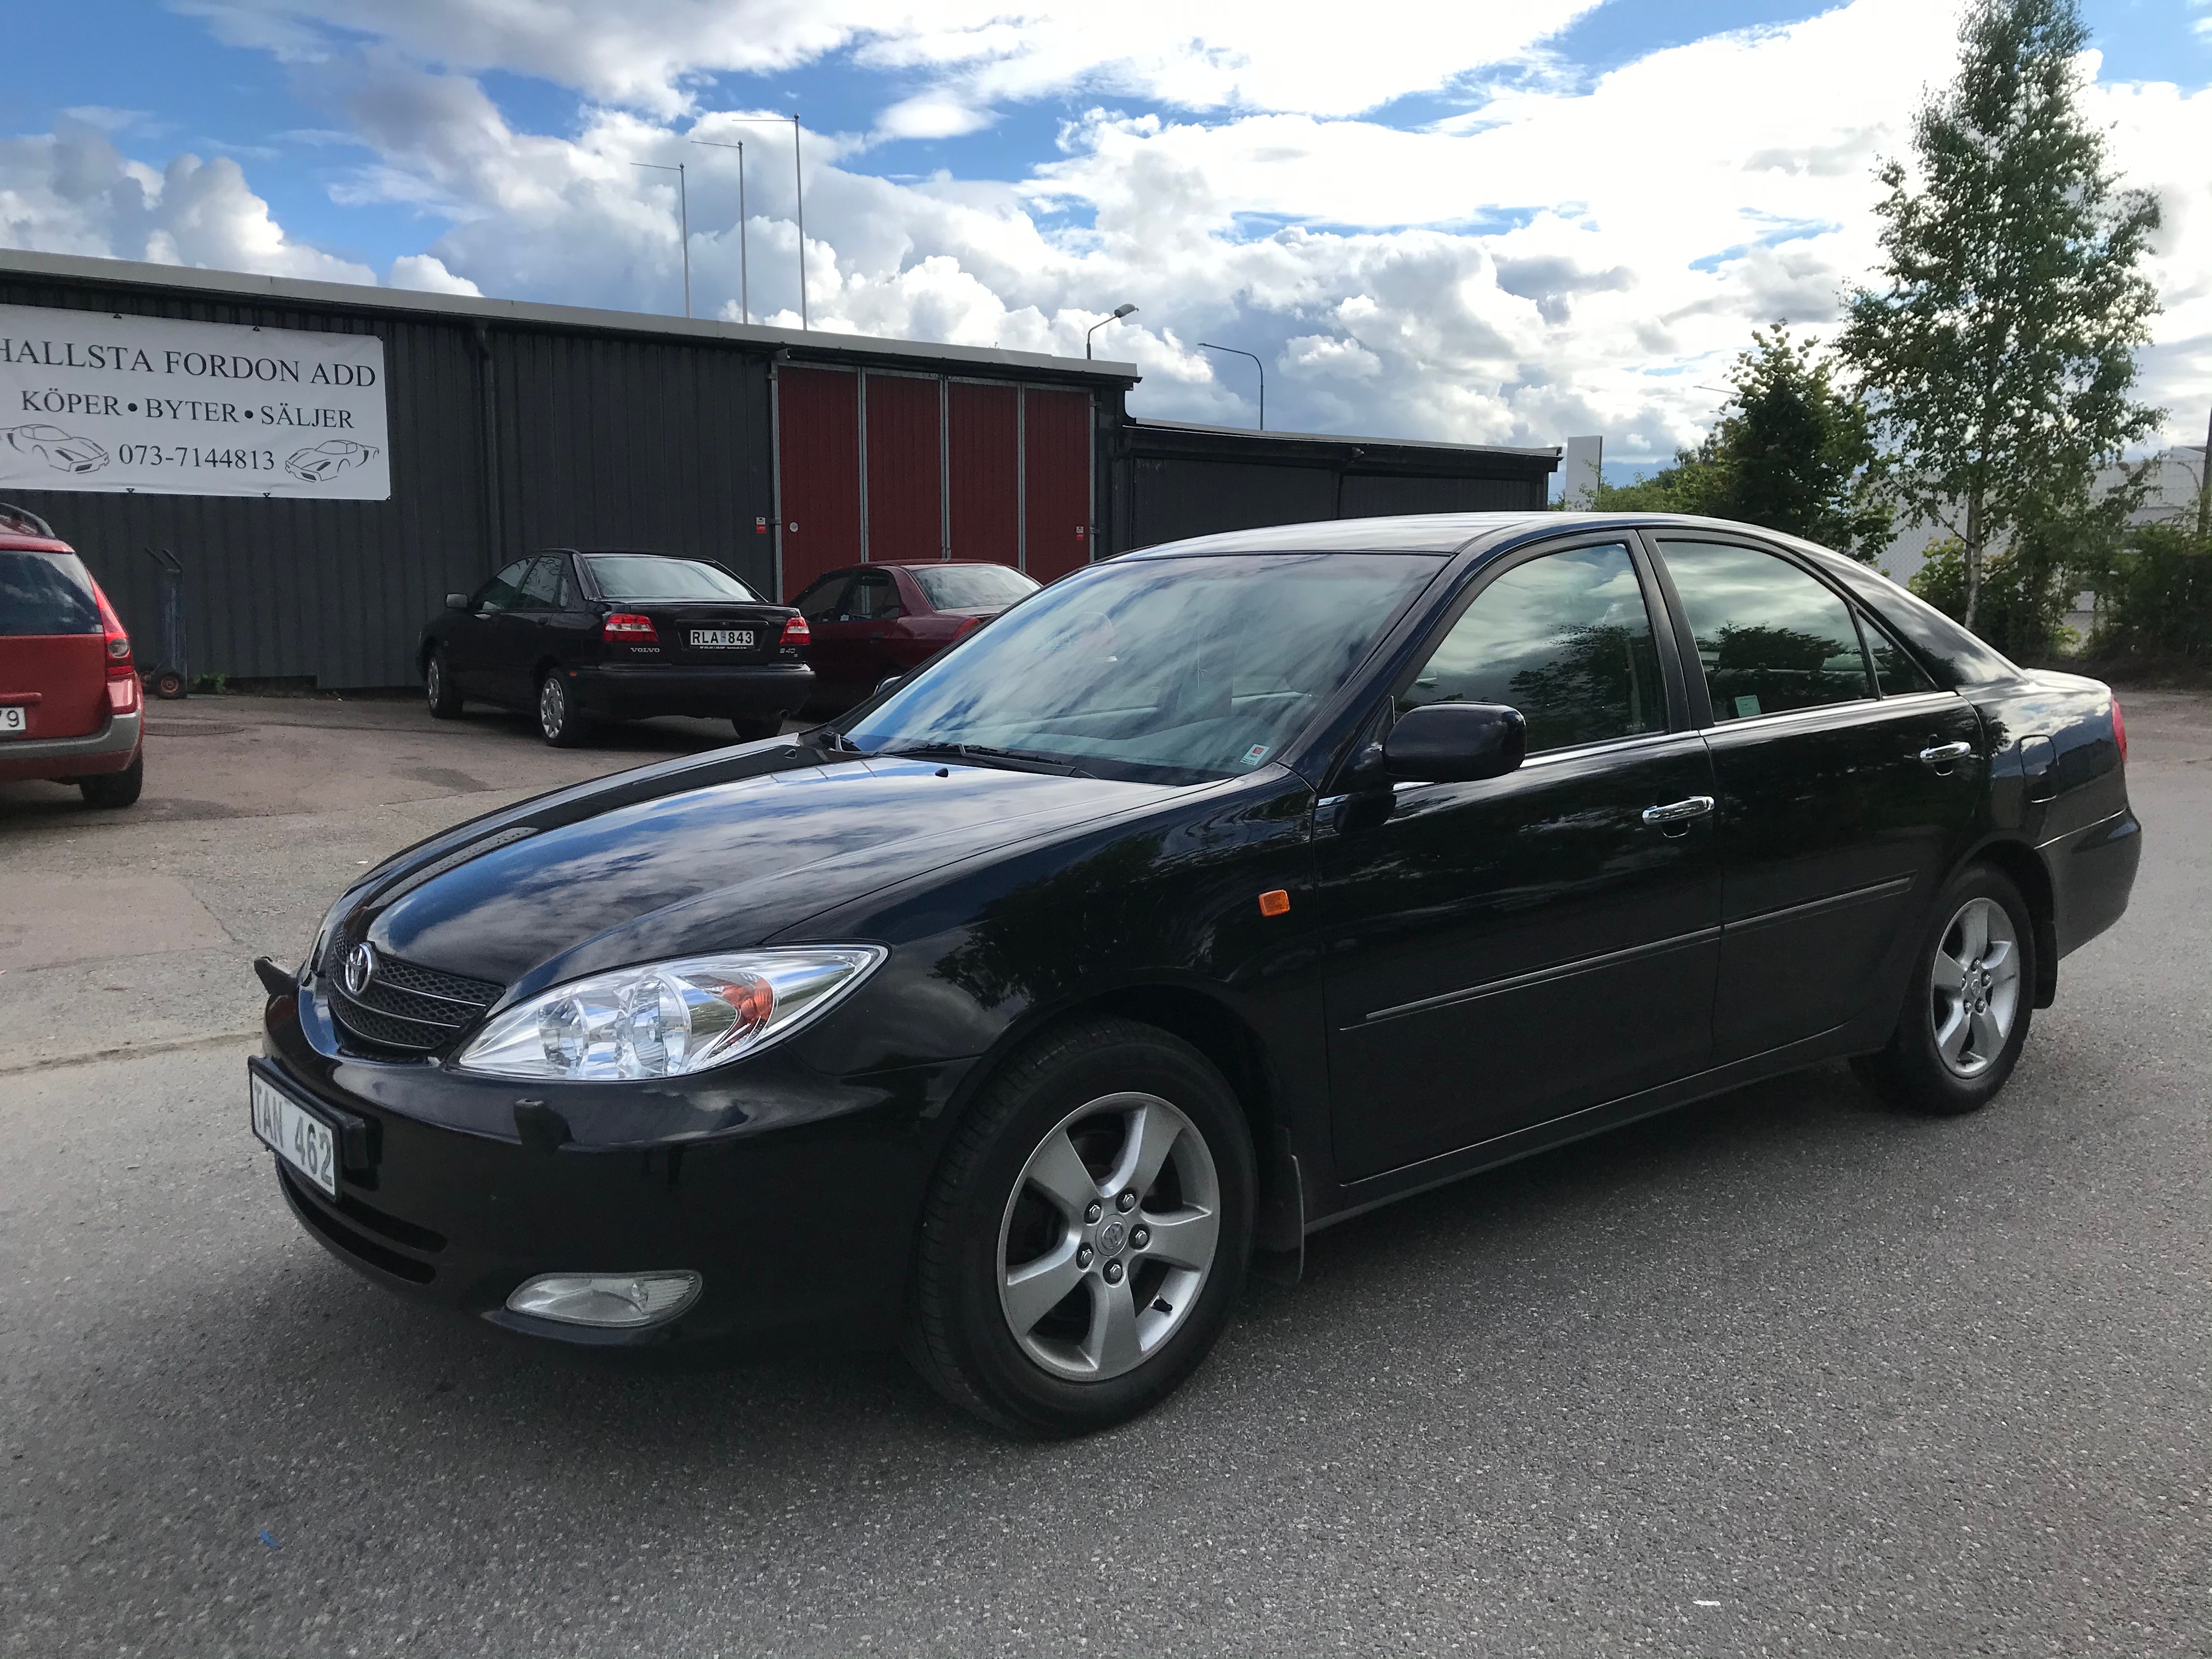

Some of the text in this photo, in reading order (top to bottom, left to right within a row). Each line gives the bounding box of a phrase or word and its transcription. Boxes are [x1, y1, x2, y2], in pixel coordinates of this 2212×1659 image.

[163, 351, 301, 383] FORDON
[309, 362, 376, 387] ADD
[21, 388, 355, 428] KÖPER BYTER SÄLJER
[119, 443, 275, 471] 073-7144813
[692, 631, 753, 644] RLA 843
[254, 1082, 332, 1187] TAN 462
